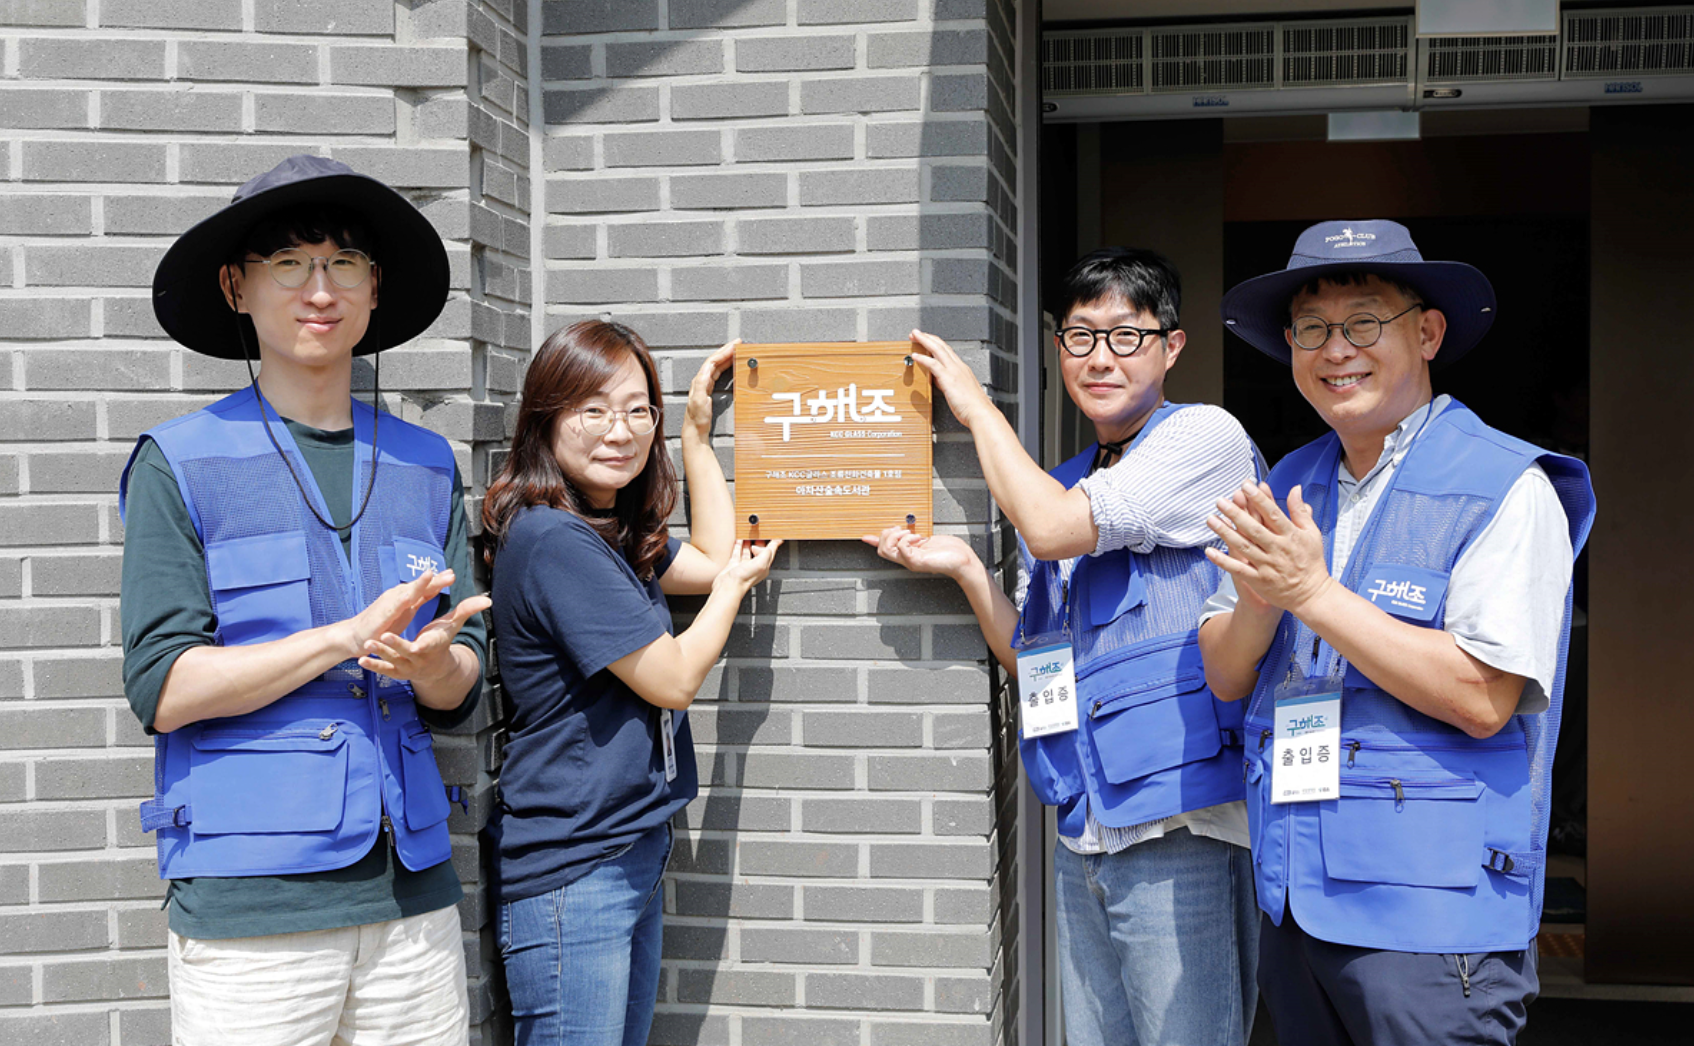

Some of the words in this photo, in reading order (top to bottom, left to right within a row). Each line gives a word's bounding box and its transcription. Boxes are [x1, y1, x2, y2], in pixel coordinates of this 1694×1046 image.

[763, 383, 903, 442] 구해조
[867, 430, 903, 438] Corporation
[1367, 579, 1427, 604] 구해조
[1029, 661, 1062, 682] 구해조
[1287, 714, 1326, 737] 구해조
